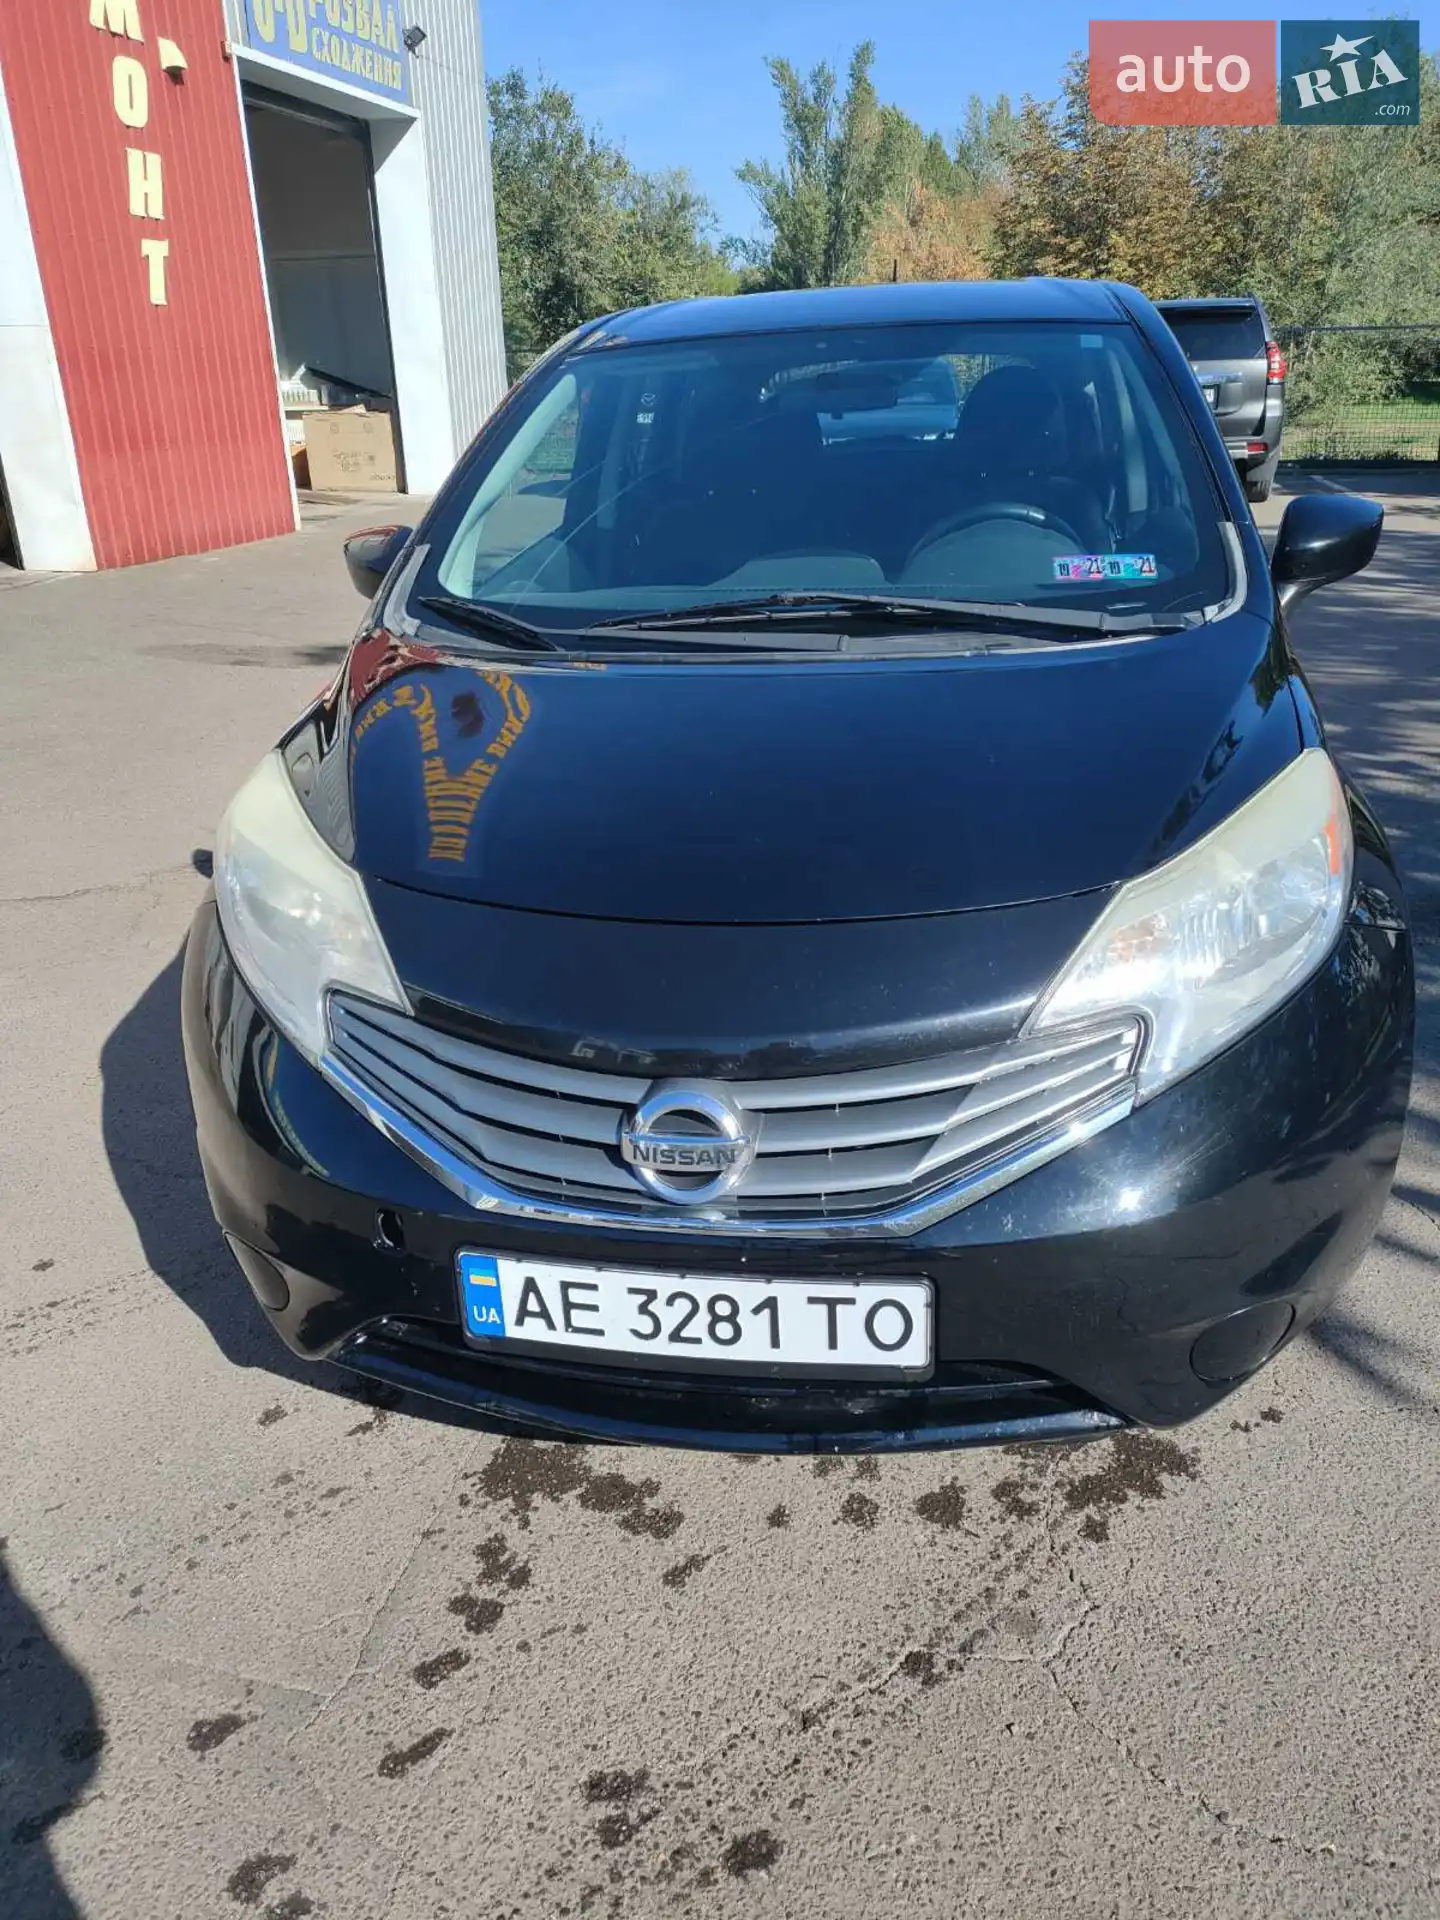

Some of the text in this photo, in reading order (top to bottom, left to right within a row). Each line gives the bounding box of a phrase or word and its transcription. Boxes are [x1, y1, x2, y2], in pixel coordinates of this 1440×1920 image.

[632, 1143, 736, 1168] NISSAN
[473, 1305, 500, 1325] UA
[514, 1276, 914, 1352] AE 3281 TO
